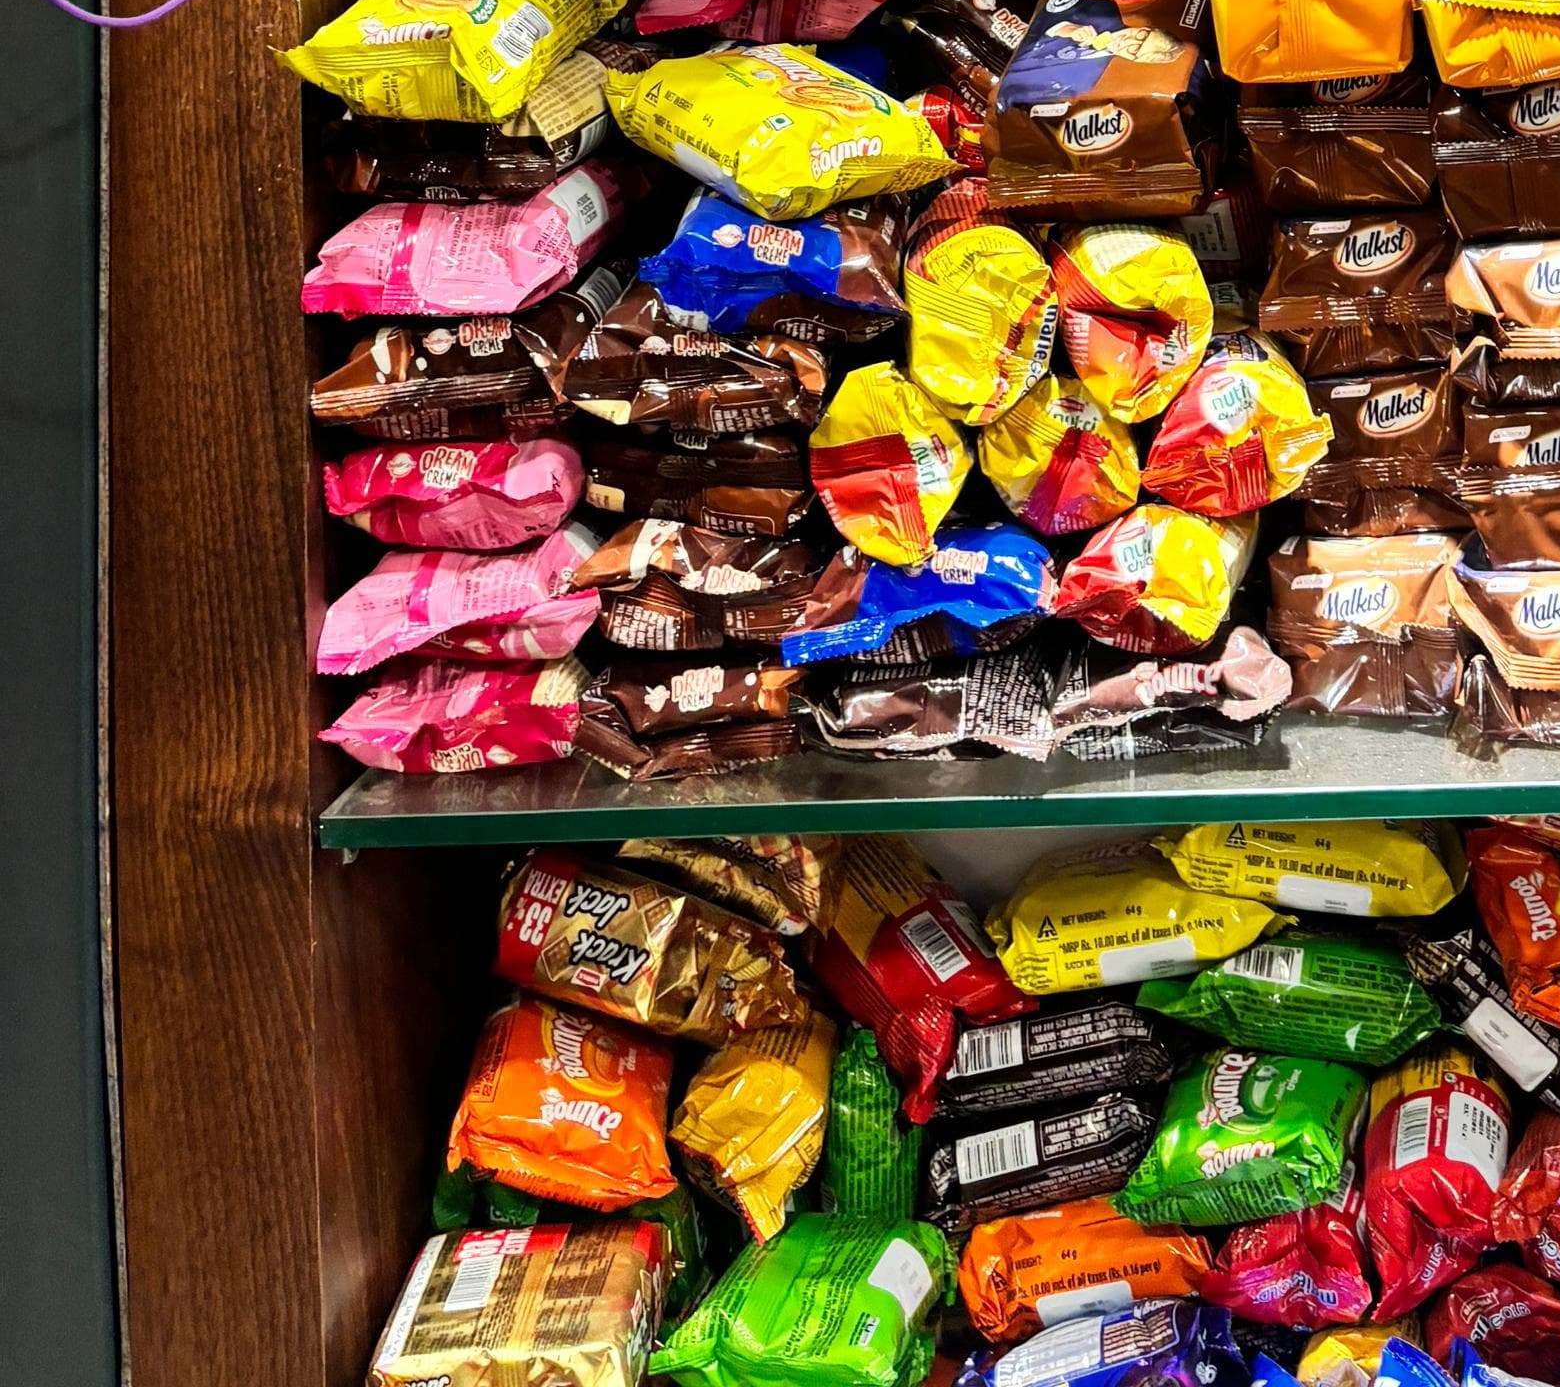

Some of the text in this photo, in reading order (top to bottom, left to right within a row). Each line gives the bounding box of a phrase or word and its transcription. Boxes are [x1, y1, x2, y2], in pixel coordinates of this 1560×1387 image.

[1061, 112, 1126, 148] Malkist
[420, 447, 476, 475] DREAM
[671, 667, 724, 694] DREAM
[523, 867, 567, 899] EXTRA
[564, 883, 631, 917] Jack
[1126, 906, 1135, 915] 64
[571, 931, 651, 985] Krack
